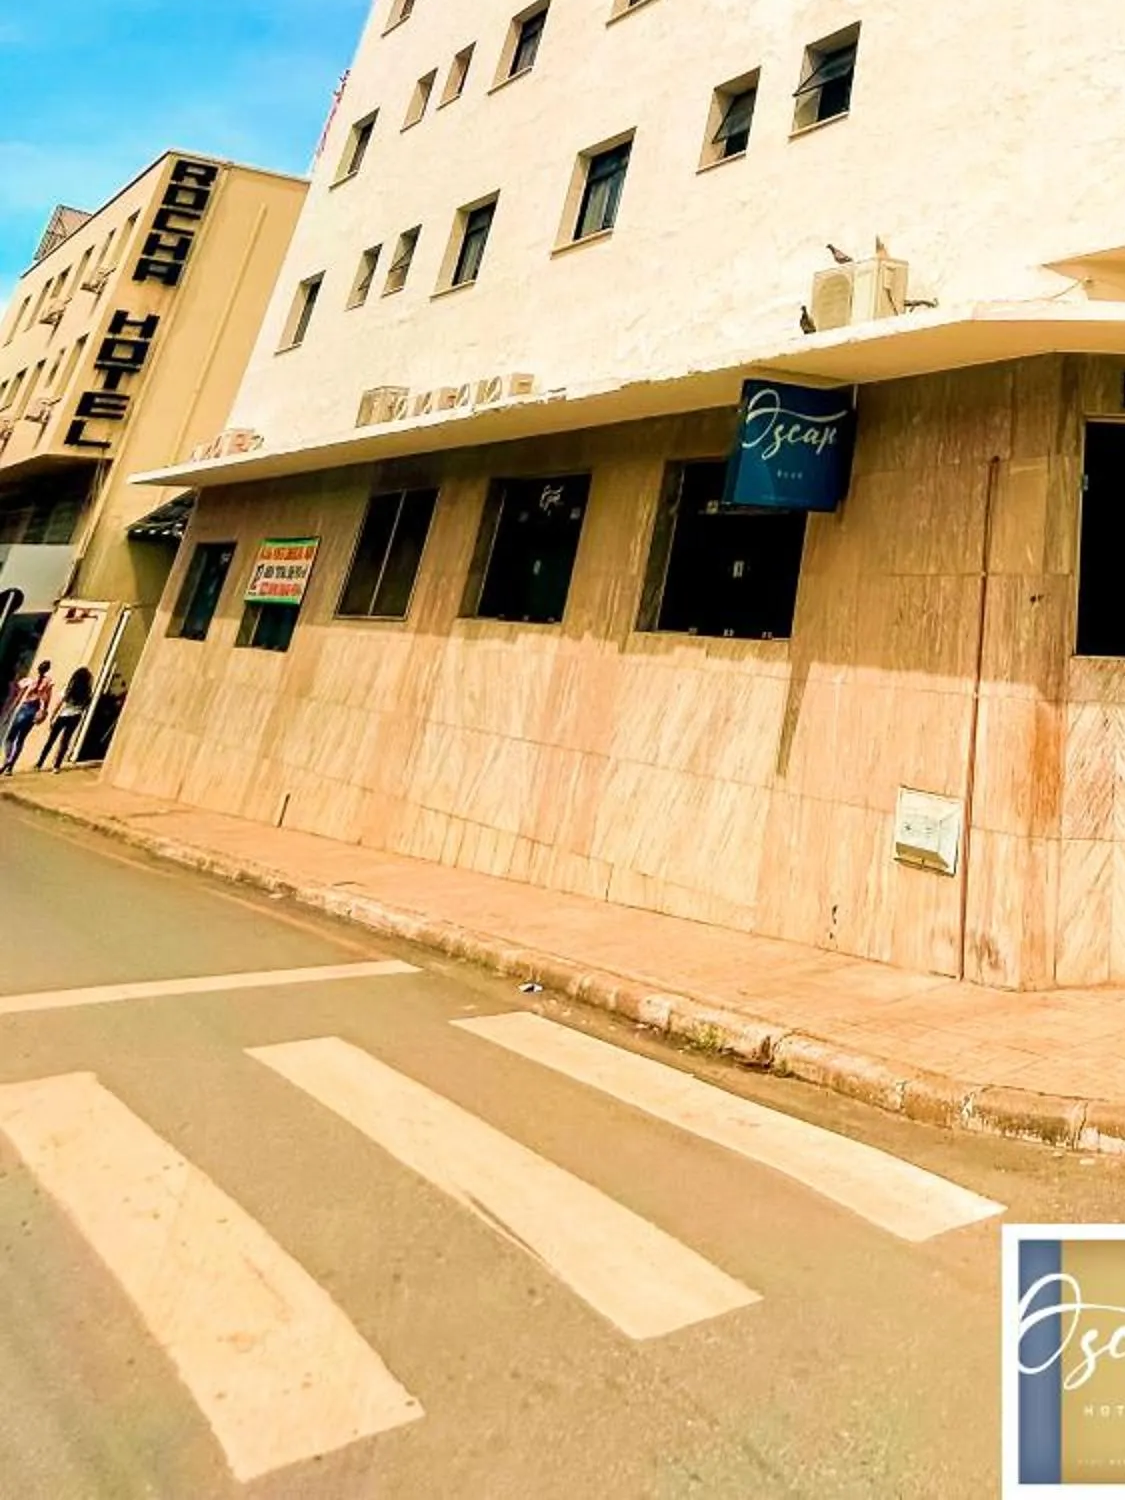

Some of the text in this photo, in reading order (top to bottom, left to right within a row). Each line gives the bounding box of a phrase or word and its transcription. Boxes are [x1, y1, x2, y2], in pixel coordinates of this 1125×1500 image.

[64, 159, 219, 449] ROCHA HOTEL
[741, 388, 848, 461] Oscar
